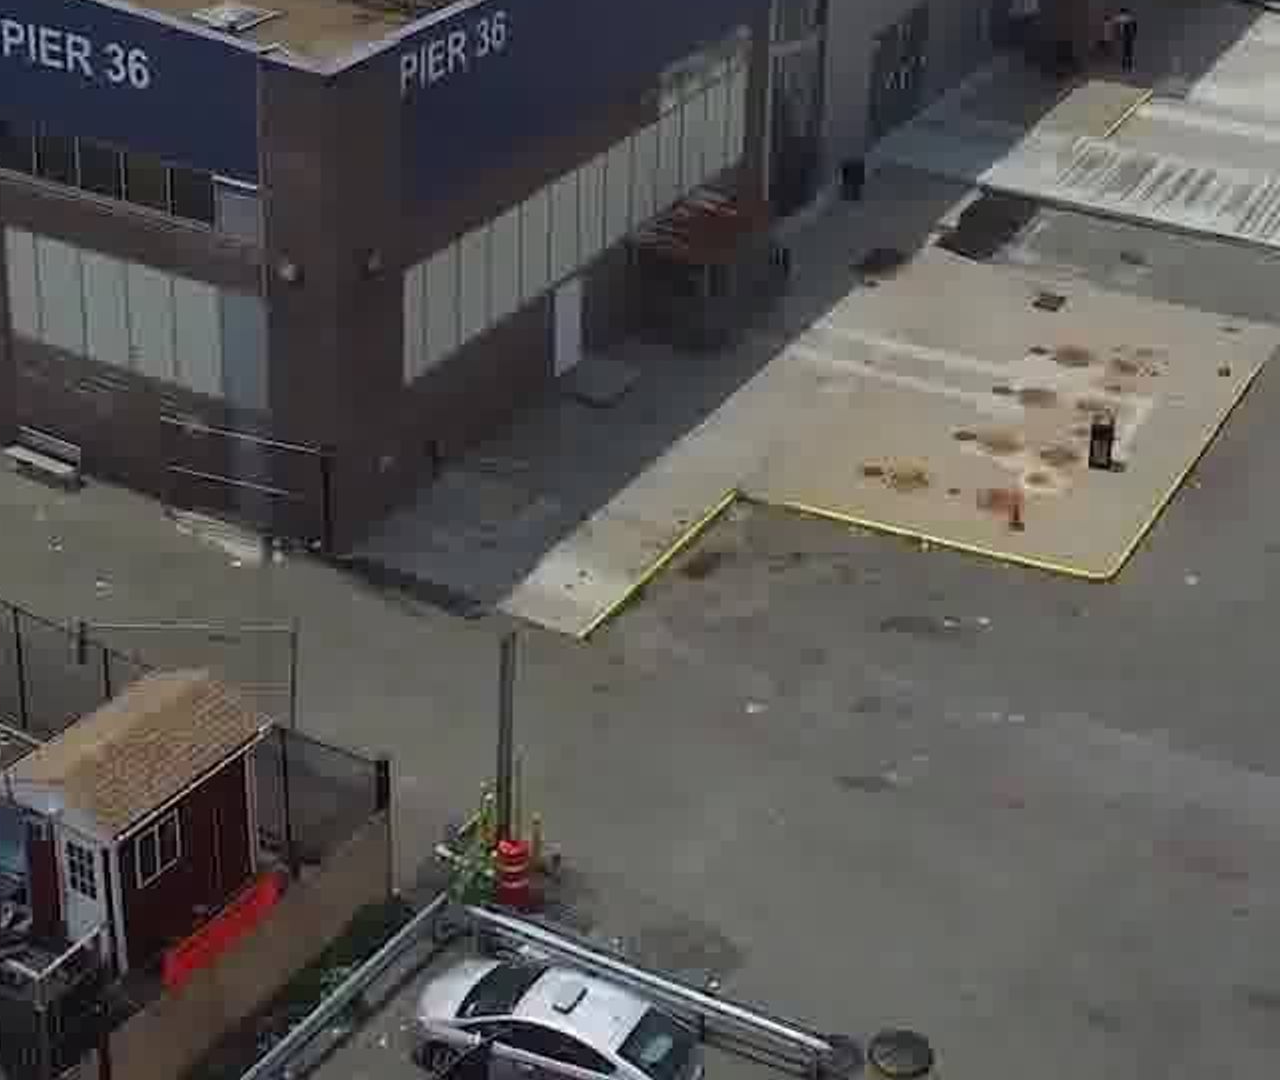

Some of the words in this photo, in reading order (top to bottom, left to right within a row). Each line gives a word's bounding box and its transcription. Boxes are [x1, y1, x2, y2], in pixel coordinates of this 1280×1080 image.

[0, 17, 94, 77] PIER
[101, 40, 151, 90] 36
[400, 29, 467, 96] PIER
[476, 8, 507, 58] 36
